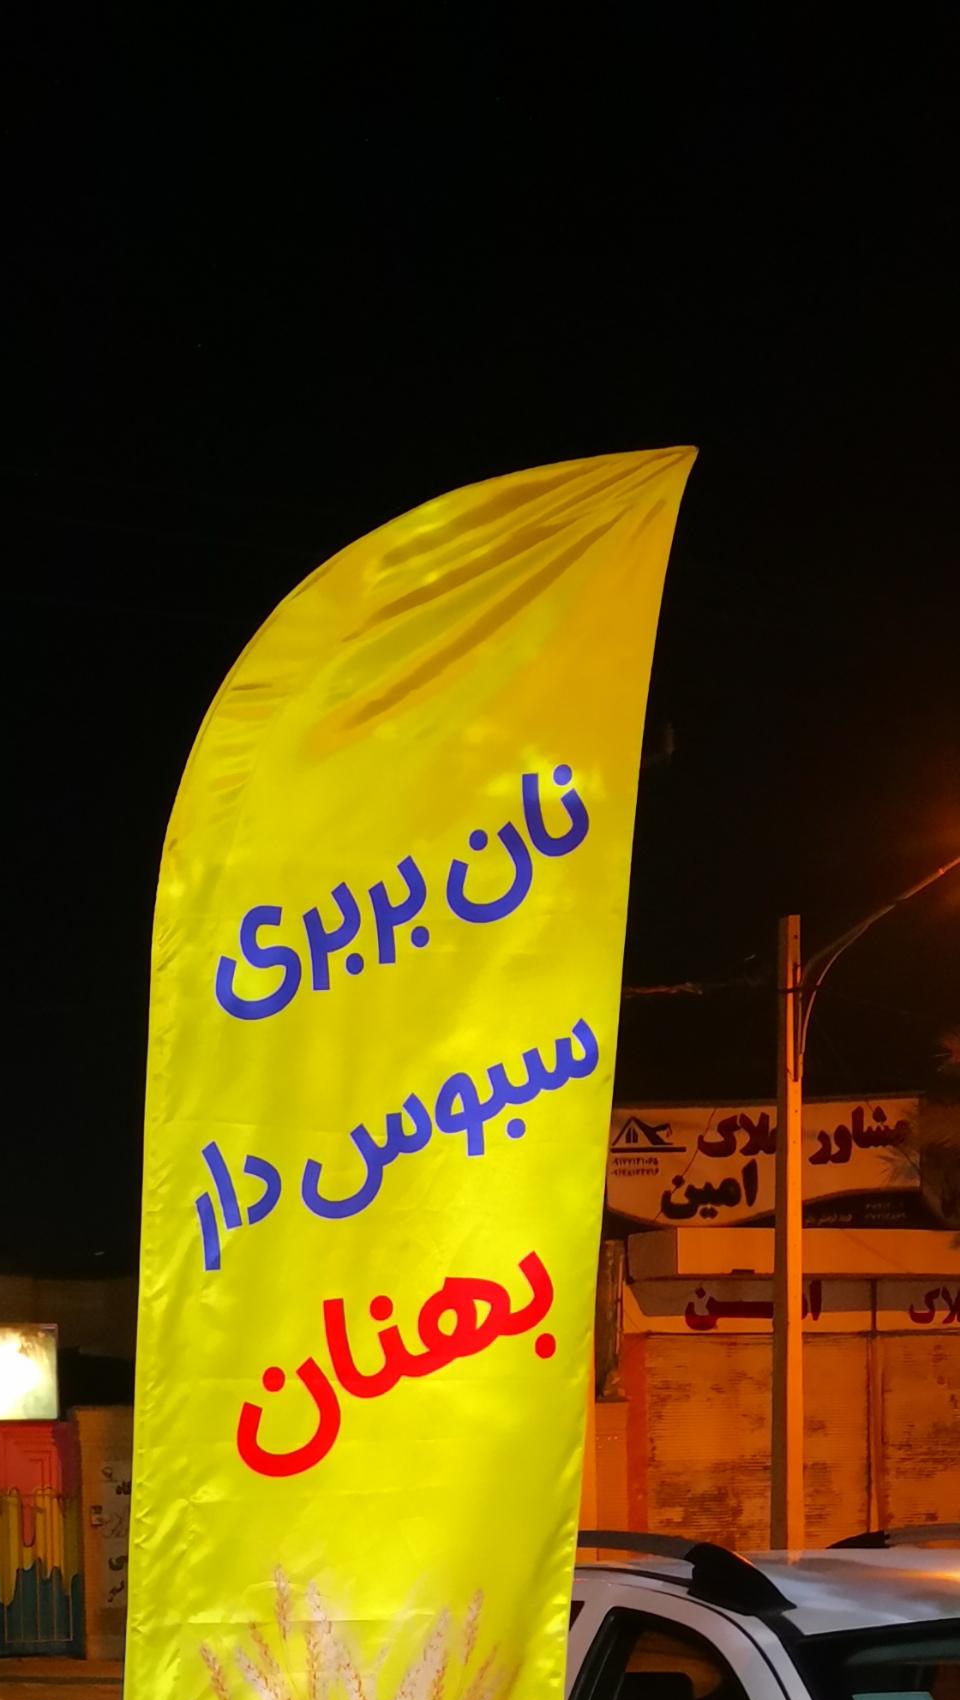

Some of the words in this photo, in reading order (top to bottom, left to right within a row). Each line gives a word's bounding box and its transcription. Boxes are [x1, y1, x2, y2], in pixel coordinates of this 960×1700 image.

[446, 763, 590, 924] نان
[215, 855, 430, 1020] بربری
[301, 1017, 600, 1219] سبوس
[661, 1159, 758, 1219] امین
[808, 1106, 913, 1164] مشاور
[193, 1141, 281, 1271] دار
[237, 1250, 558, 1478] بهنان
